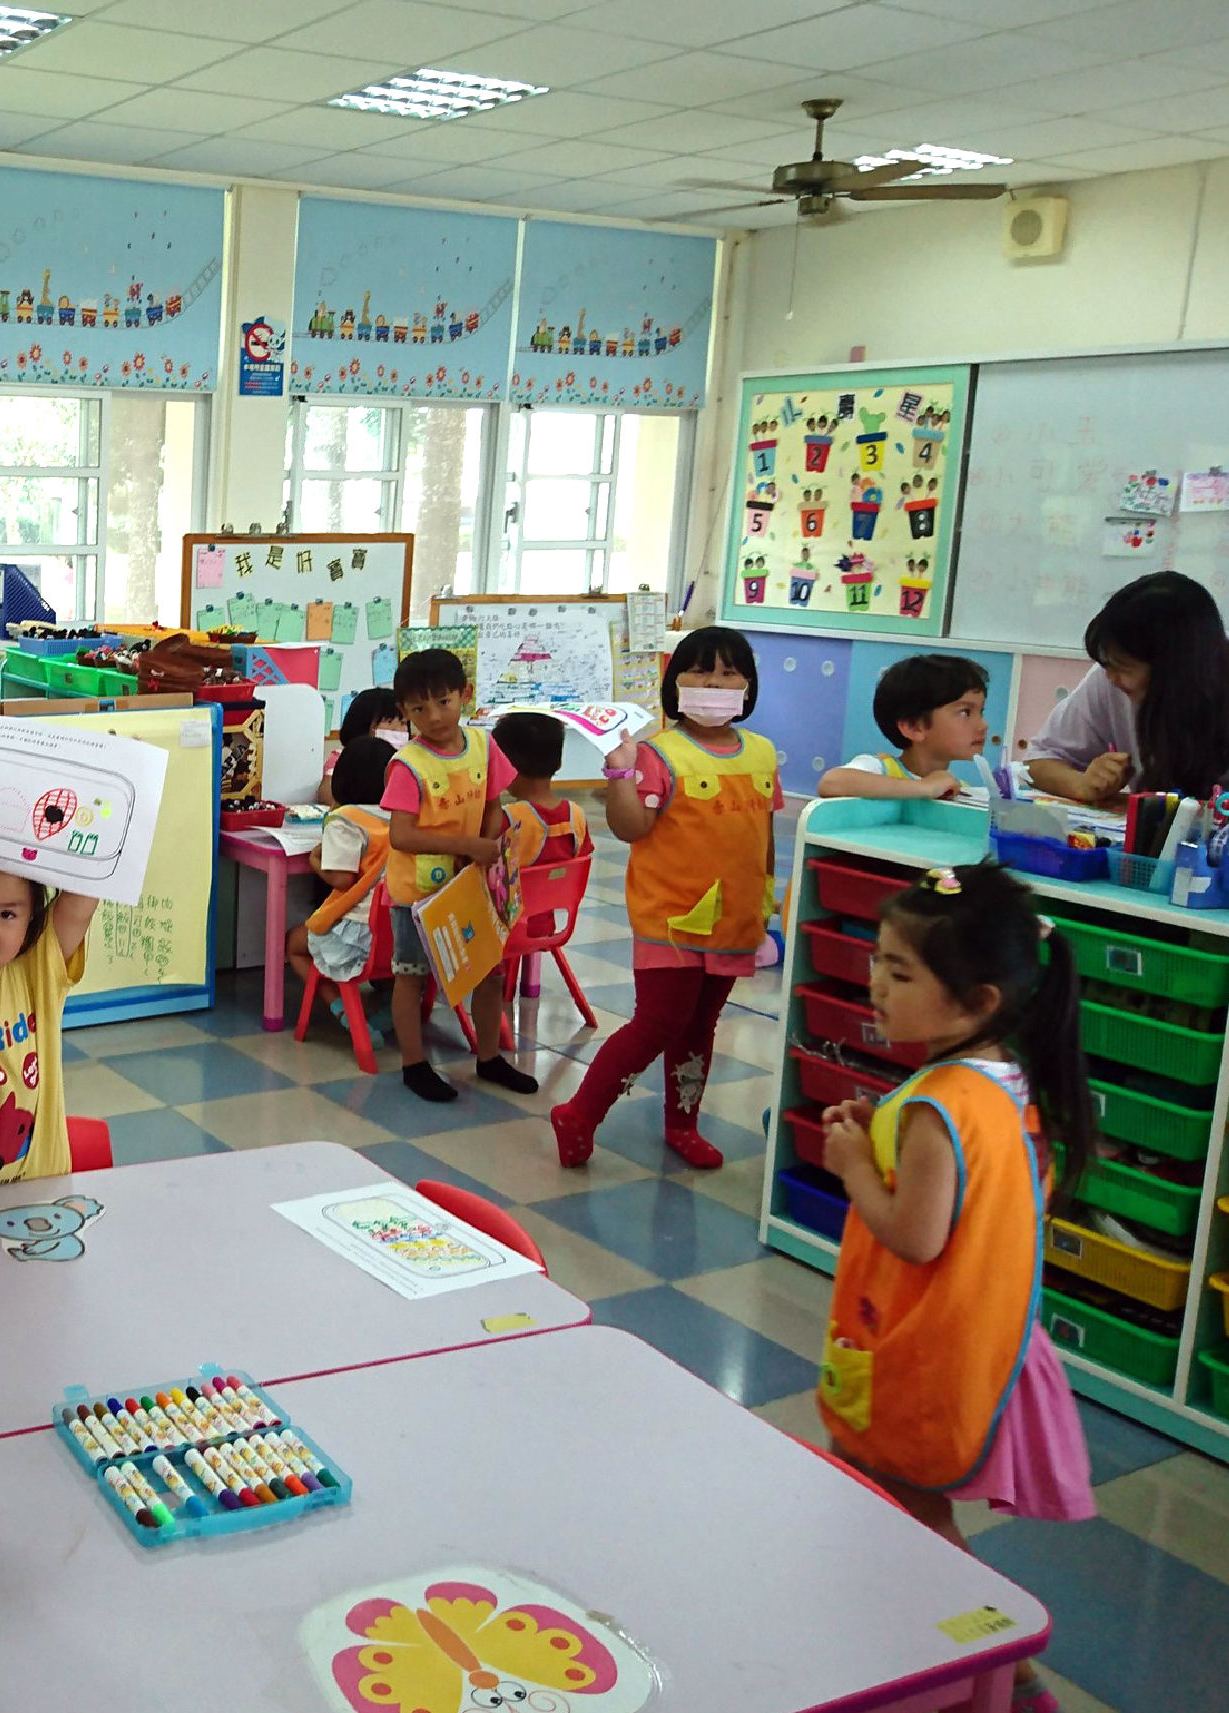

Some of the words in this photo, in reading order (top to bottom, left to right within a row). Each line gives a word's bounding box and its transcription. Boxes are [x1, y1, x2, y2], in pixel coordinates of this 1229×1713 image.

[757, 453, 769, 473] 1
[810, 446, 822, 467] 2
[865, 444, 879, 465] 3
[919, 442, 933, 463] 4
[751, 513, 763, 532] 5
[806, 513, 818, 532] 6
[748, 581, 759, 599] 9
[792, 582, 809, 600] 10
[849, 585, 868, 605] 11
[901, 590, 925, 612] 12
